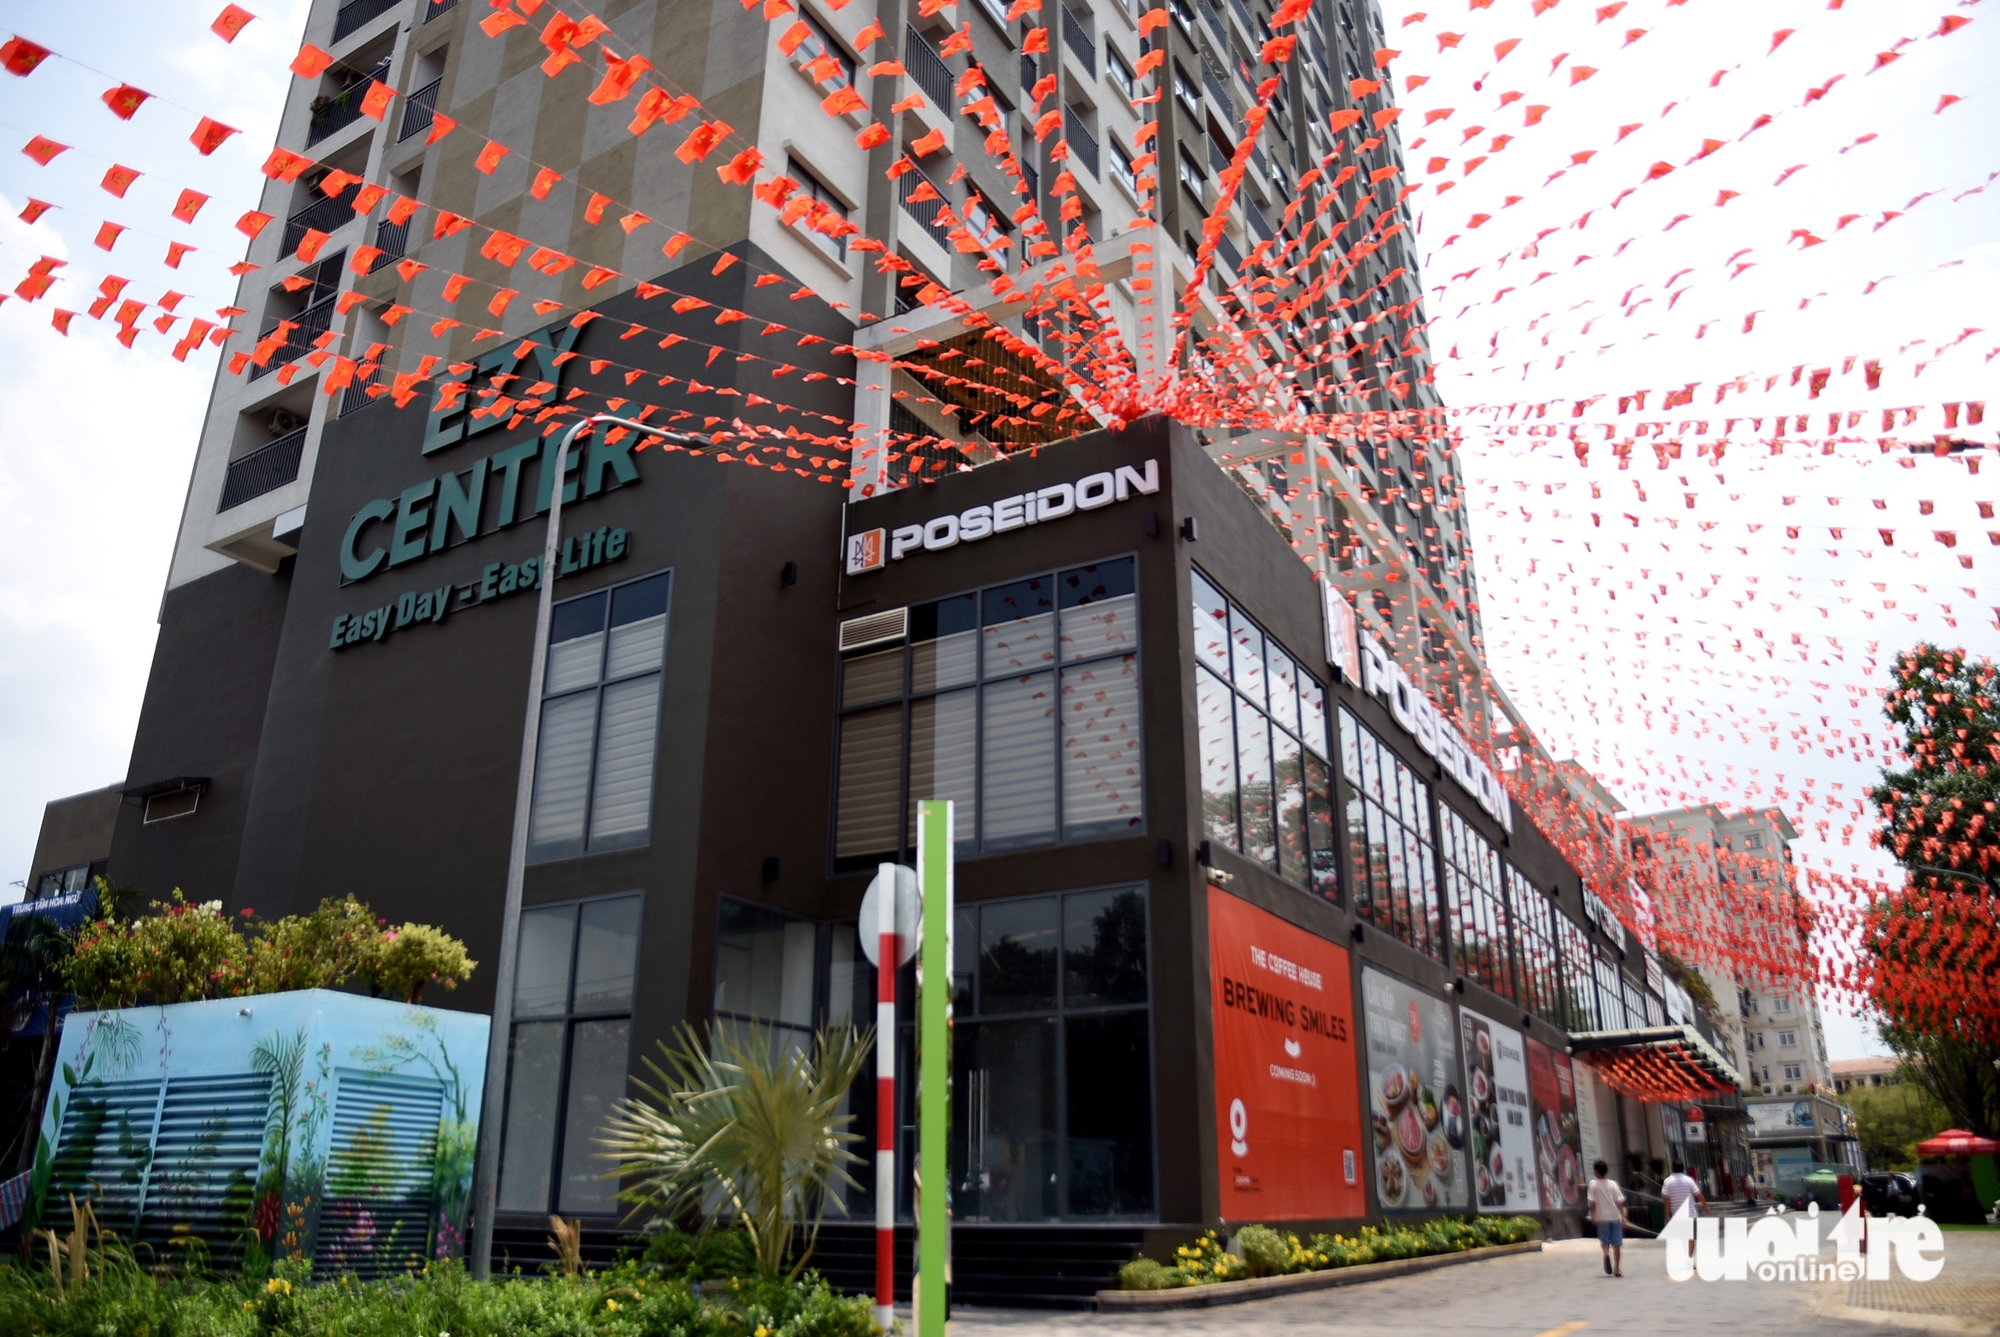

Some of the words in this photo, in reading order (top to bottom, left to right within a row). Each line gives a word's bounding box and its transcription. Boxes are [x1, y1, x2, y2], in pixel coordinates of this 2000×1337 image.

[422, 319, 586, 456] EZY
[339, 403, 642, 580] CENTER
[329, 604, 395, 650] Easy
[395, 584, 454, 630] Day
[560, 525, 630, 576] Life
[12, 902, 34, 915] TRUNG
[1250, 945, 1267, 969] THE
[1267, 953, 1298, 981] COFFEE
[1298, 965, 1323, 991] HOUSE
[1222, 977, 1296, 1027] BREWING
[1300, 1004, 1347, 1042] SMILES
[1269, 1063, 1294, 1081] COMING
